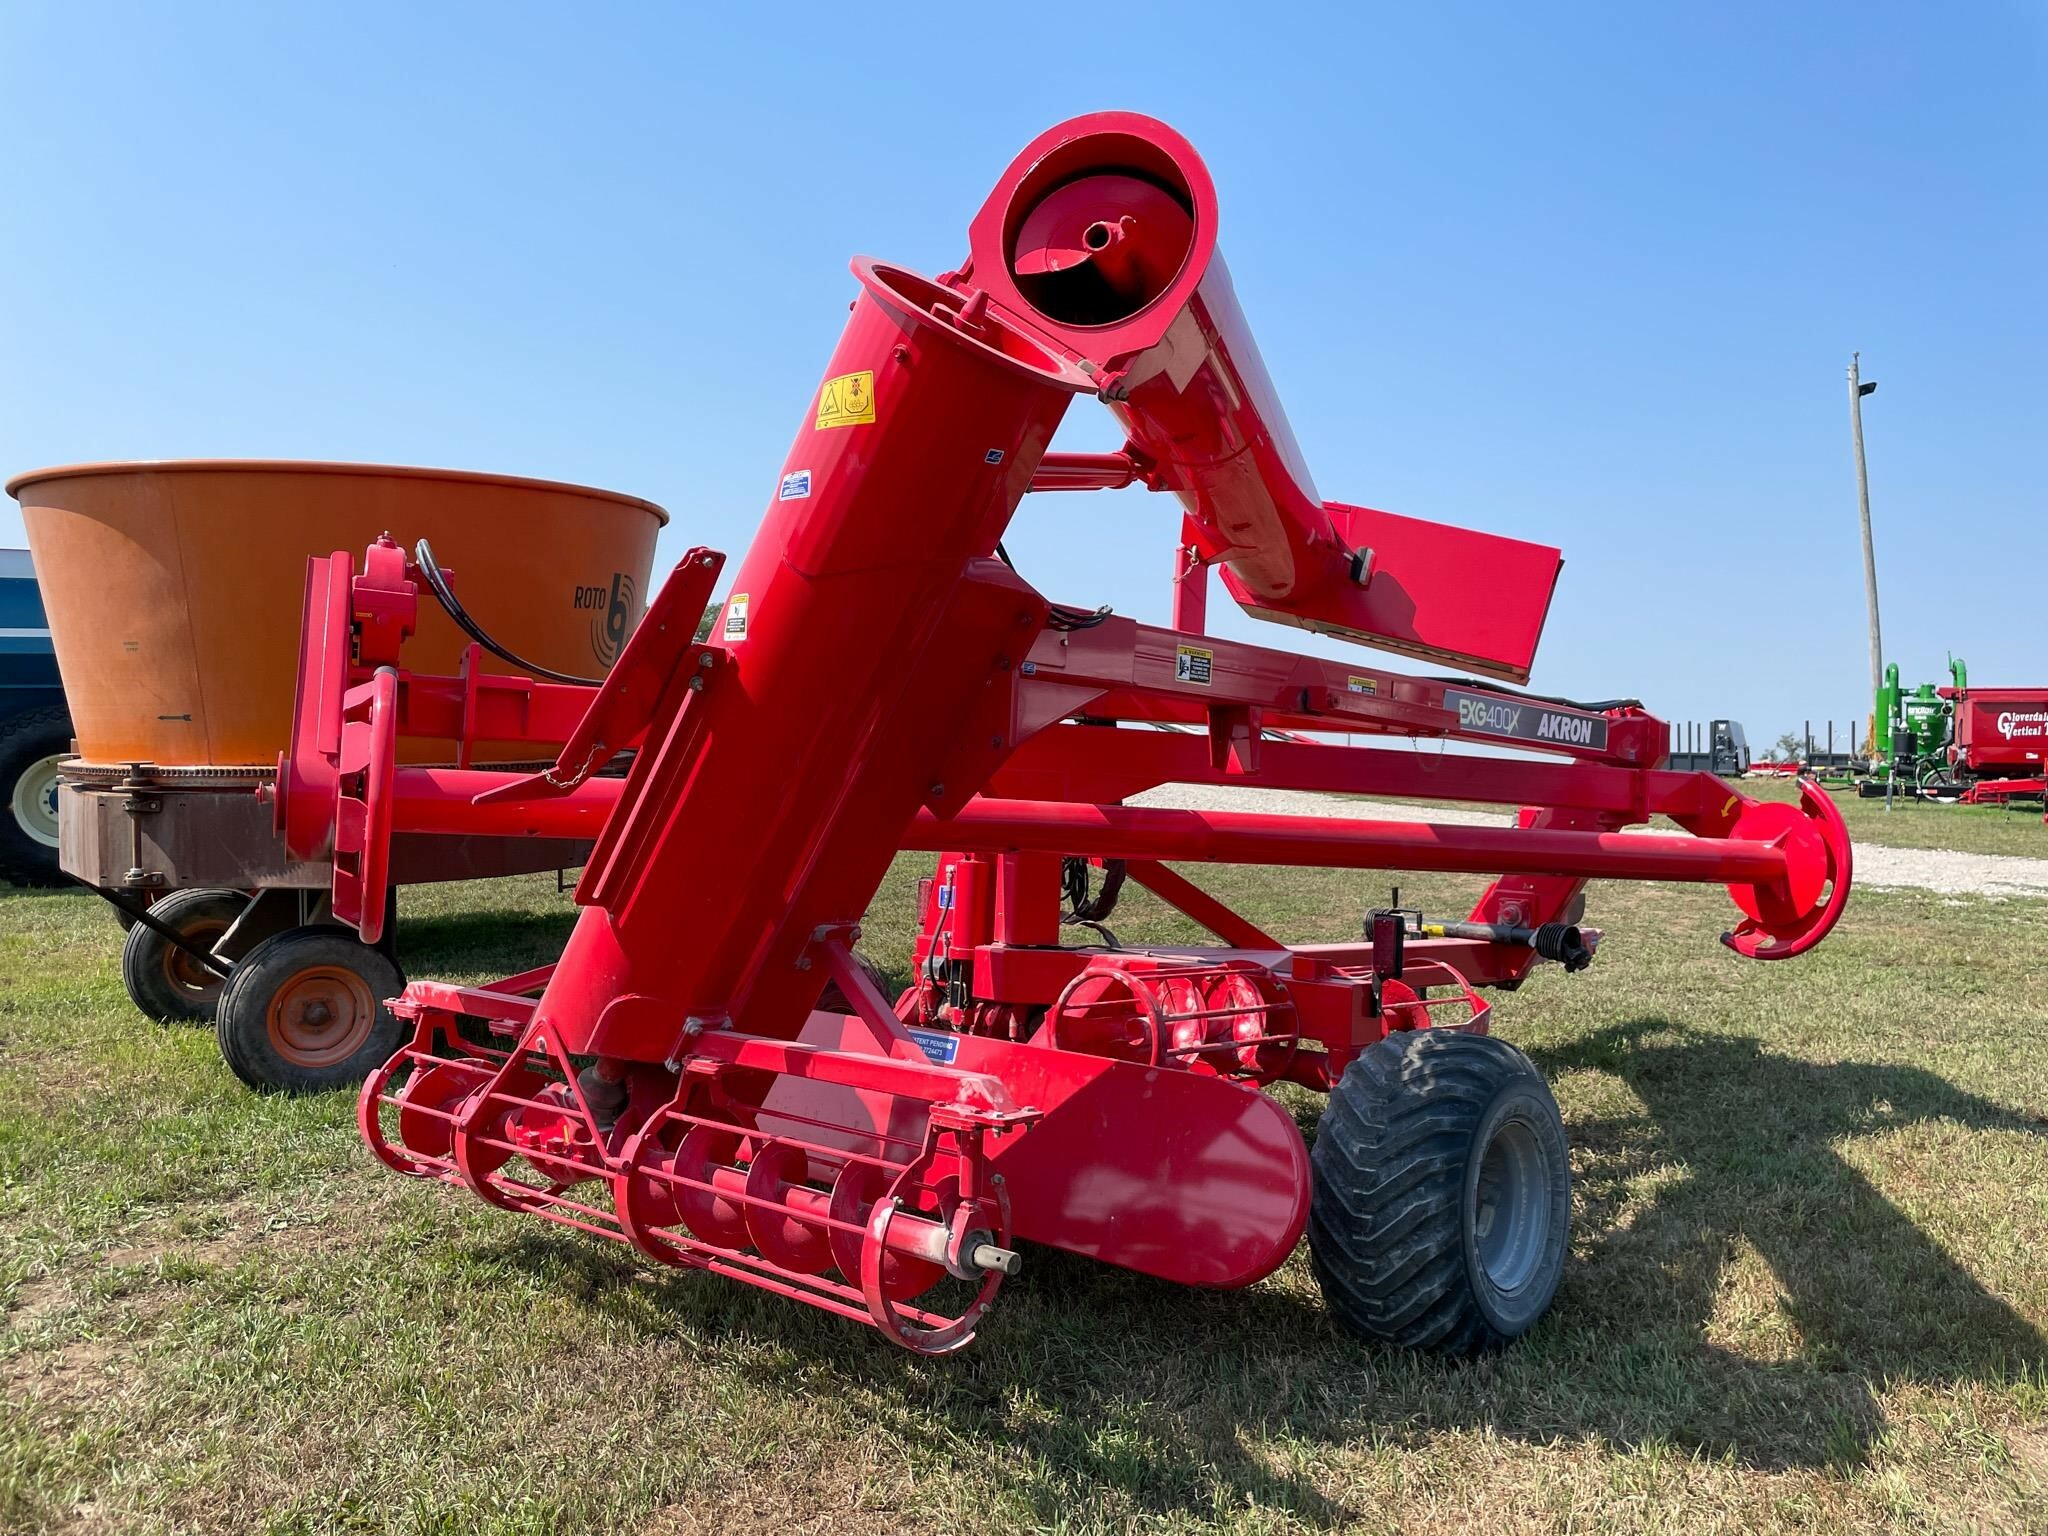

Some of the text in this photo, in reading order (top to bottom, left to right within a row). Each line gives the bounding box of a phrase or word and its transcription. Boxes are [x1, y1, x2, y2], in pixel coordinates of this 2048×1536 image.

[574, 586, 606, 610] ROTO
[1459, 699, 1592, 744] EXG400X AKRON
[2003, 721, 2042, 740] Vertical
[929, 1039, 953, 1050] PENDING
